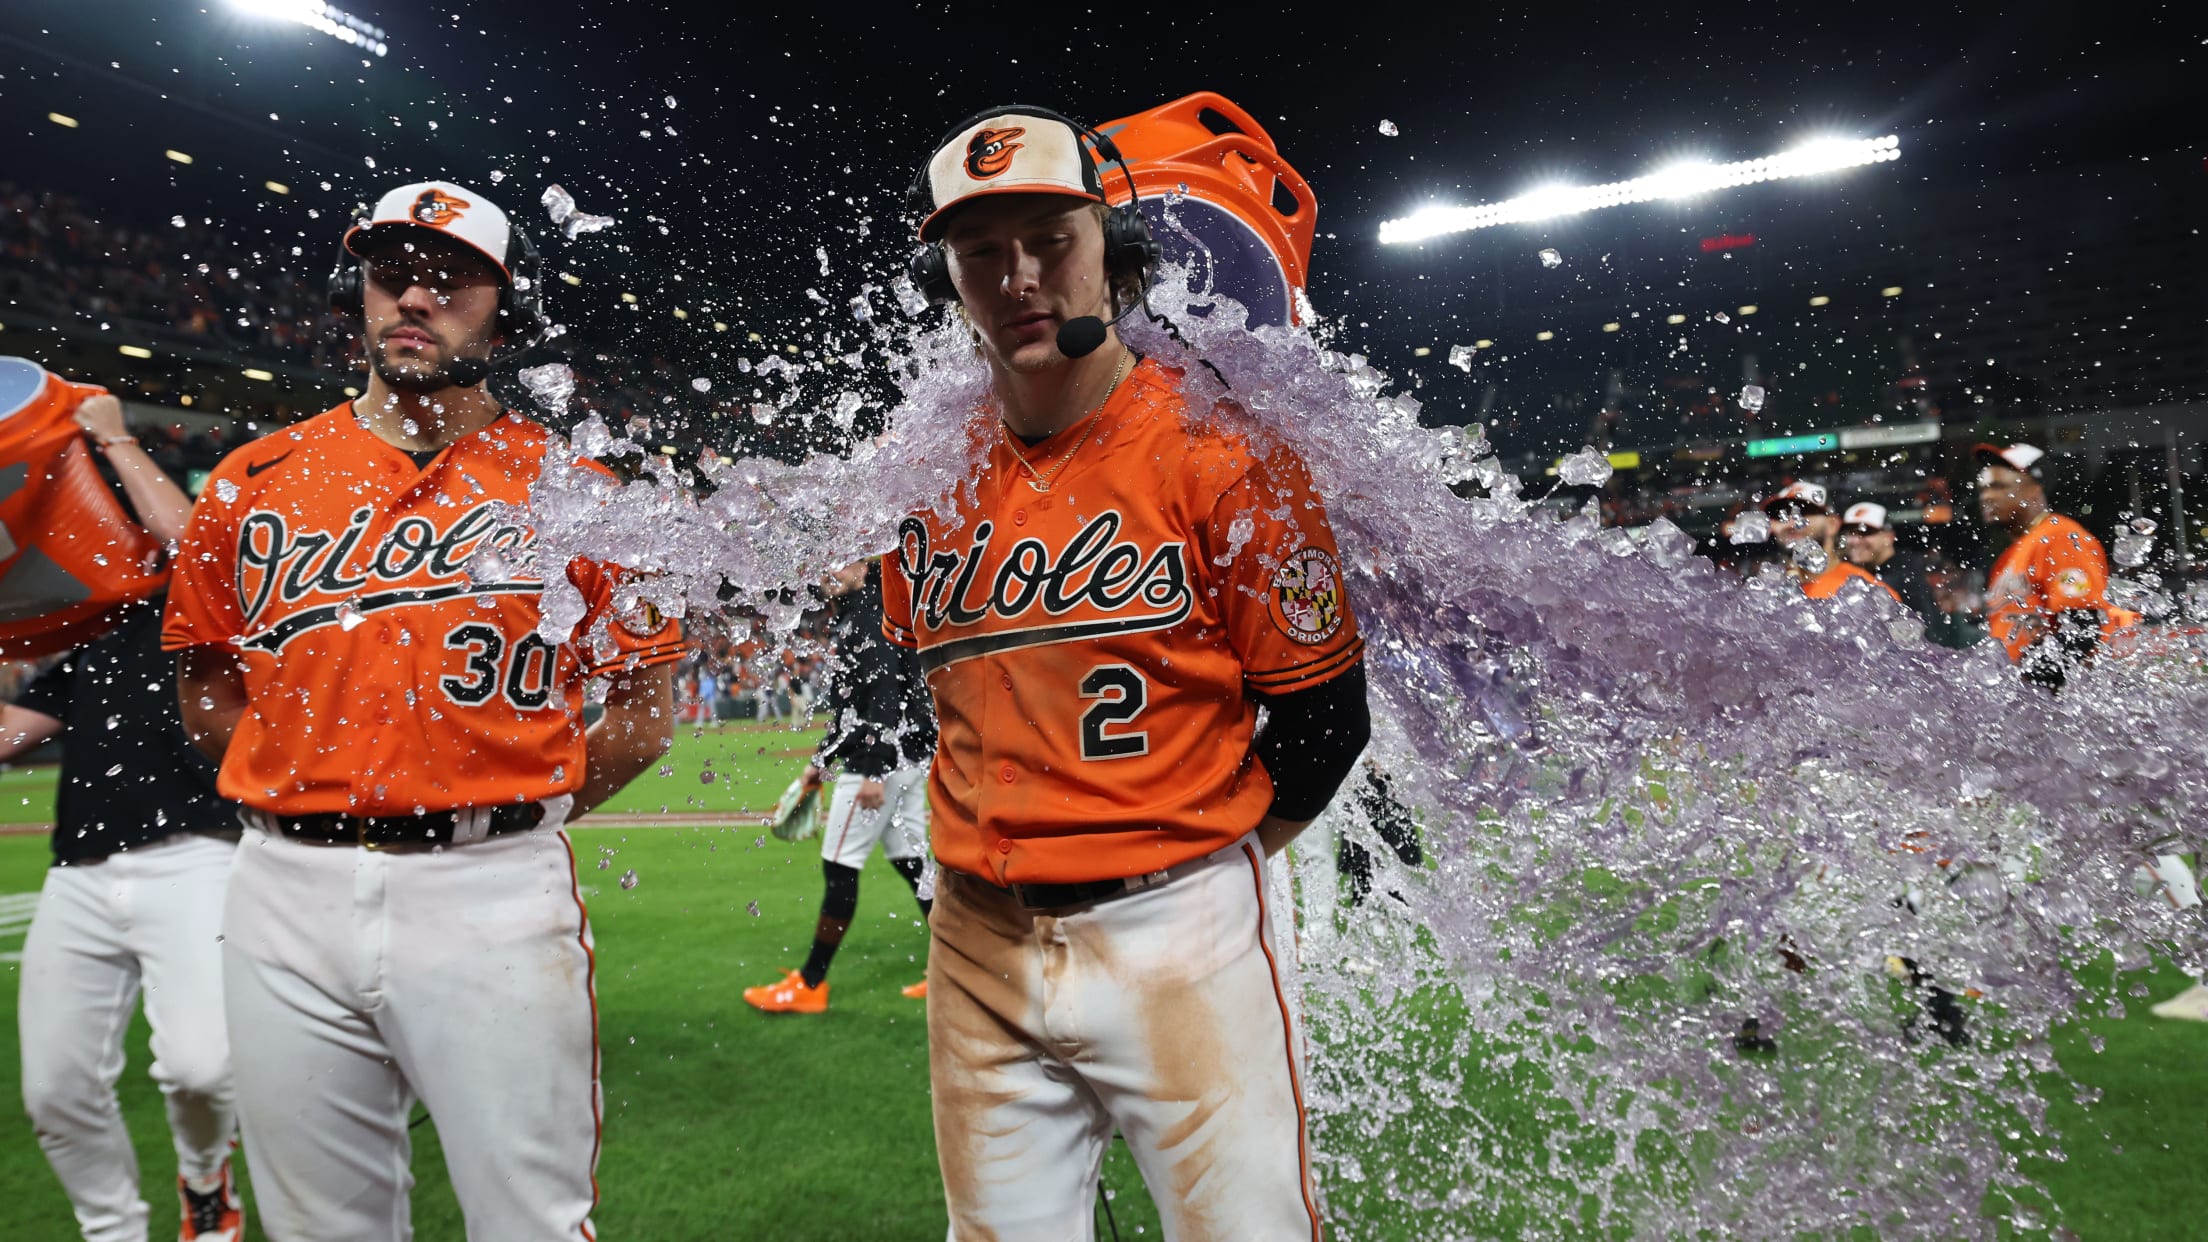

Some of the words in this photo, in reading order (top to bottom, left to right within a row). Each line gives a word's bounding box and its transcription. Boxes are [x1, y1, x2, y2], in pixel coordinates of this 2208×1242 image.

[237, 499, 543, 626] Oriole
[898, 509, 1192, 631] Orioles
[1273, 549, 1338, 588] BATIMORE
[438, 622, 557, 711] 30
[1287, 615, 1341, 642] ORIOLES
[1078, 663, 1148, 761] 2
